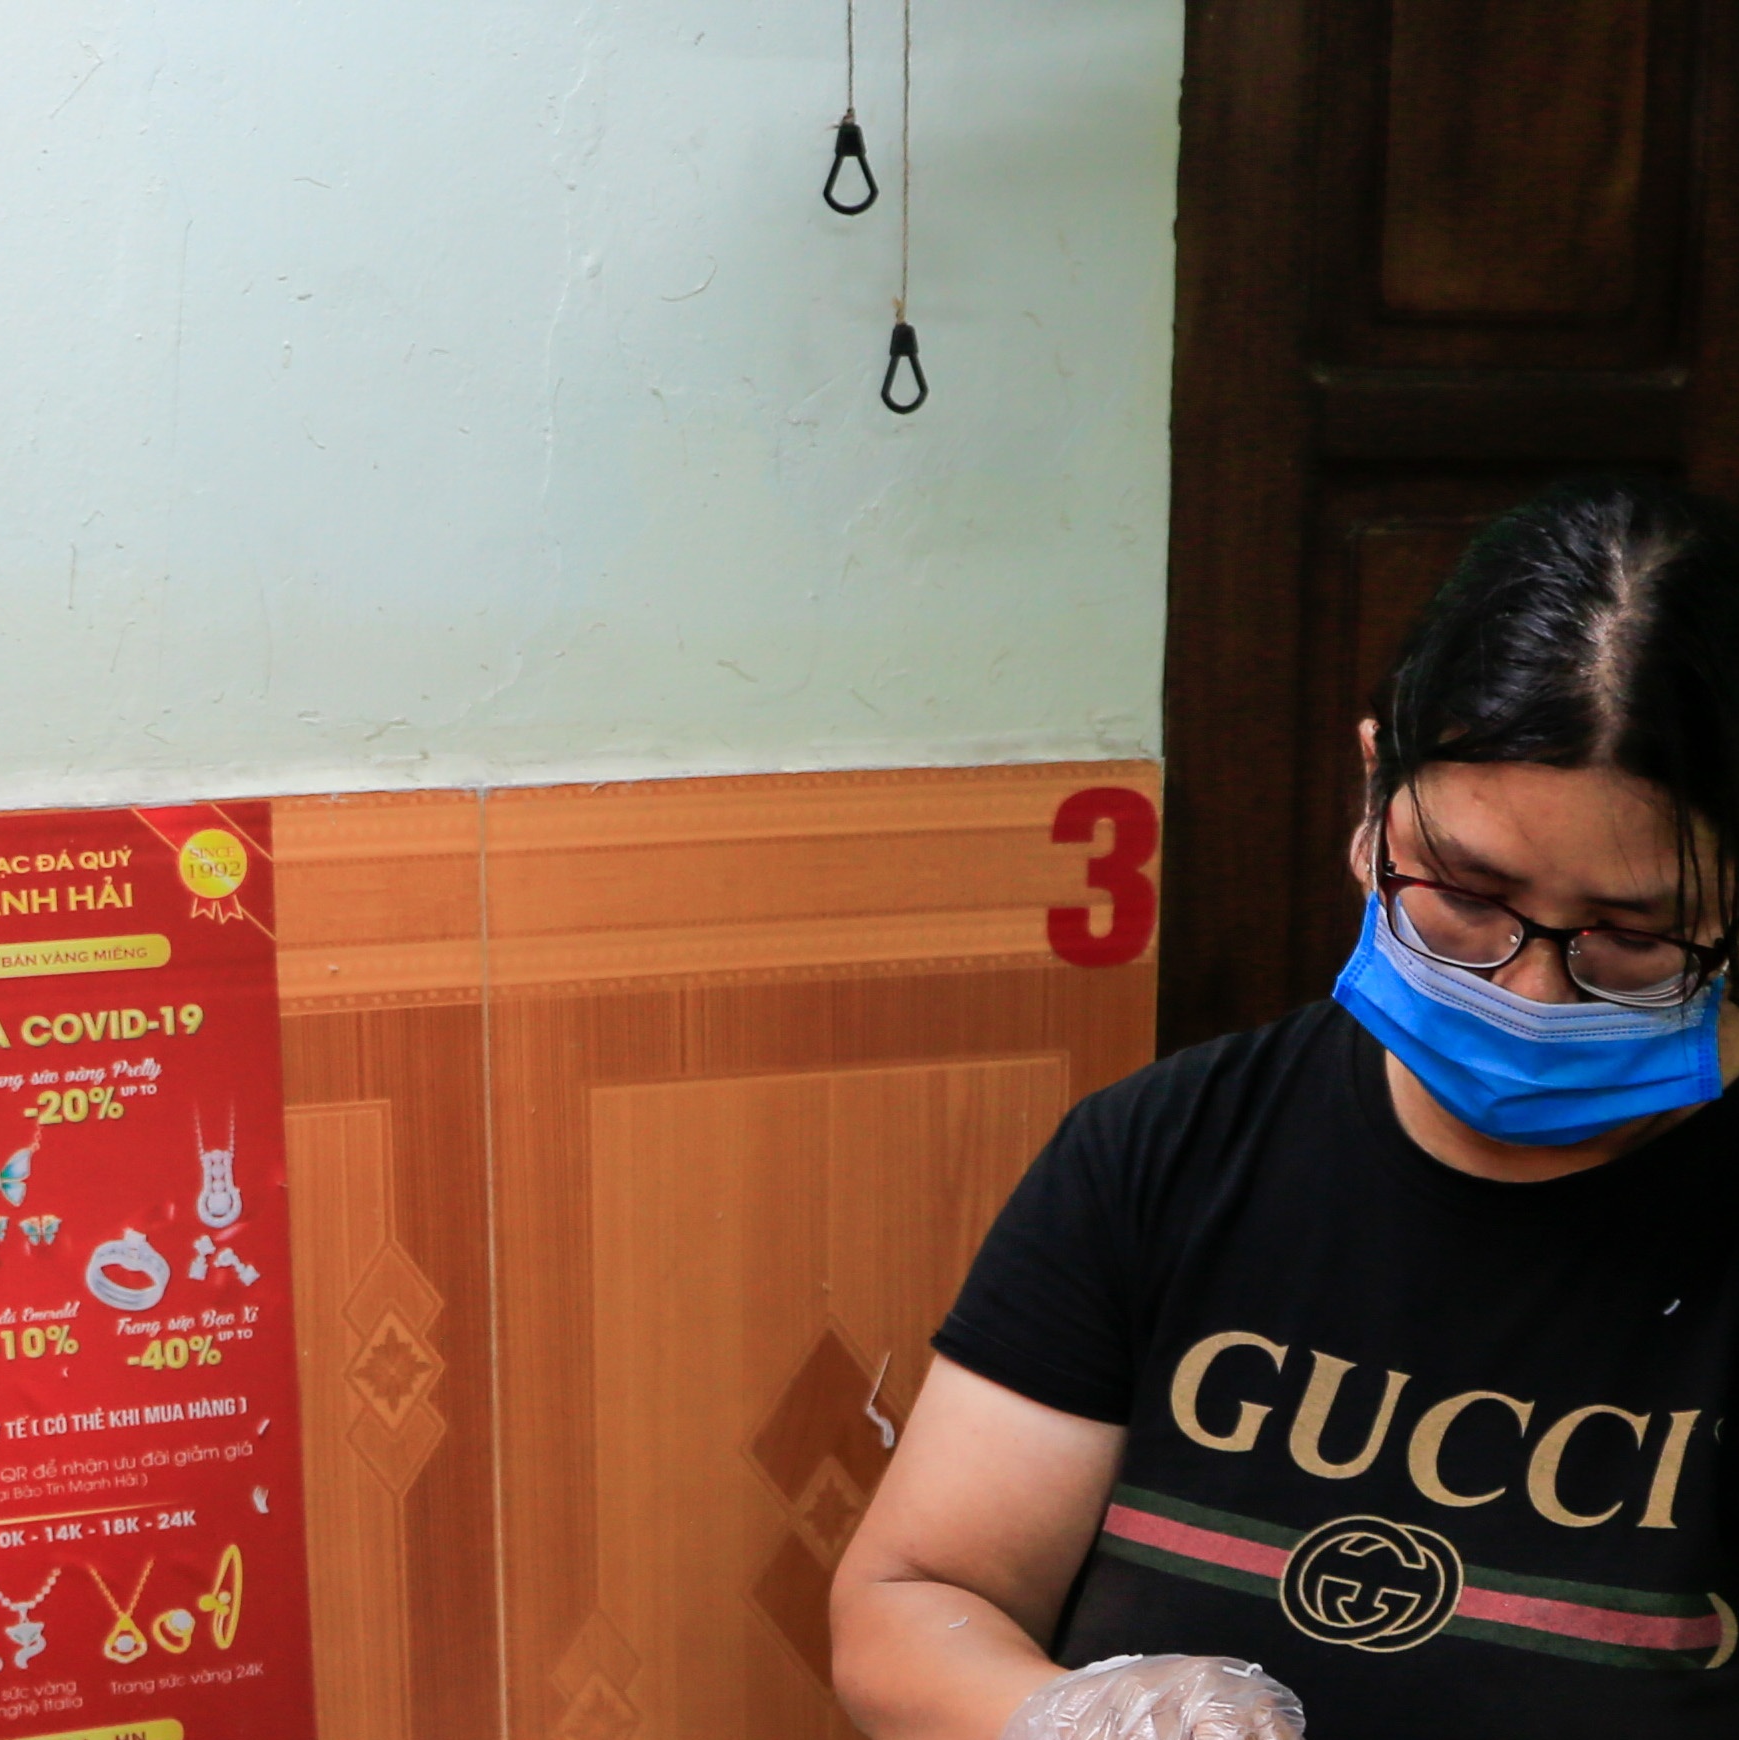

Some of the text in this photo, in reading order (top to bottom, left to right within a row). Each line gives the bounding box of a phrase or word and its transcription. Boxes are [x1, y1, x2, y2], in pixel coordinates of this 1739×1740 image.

[36, 851, 74, 872] ĐÁ
[79, 846, 132, 870] QUÝ
[189, 861, 241, 880] 1992
[190, 846, 235, 859] SINCE
[68, 876, 133, 911] HẢI
[1047, 787, 1158, 968] 3
[2, 953, 38, 968] BÁN
[43, 950, 88, 964] VÀNG
[94, 946, 148, 961] MIẾNG
[21, 1004, 204, 1047] COVID-19
[24, 1084, 157, 1125] -20% UP TO
[126, 1328, 253, 1370] -40% UP TO
[5, 1416, 30, 1438] TẾ
[43, 1413, 68, 1436] CÓ
[72, 1407, 105, 1431] THẺ
[110, 1407, 140, 1428] KHI
[145, 1402, 185, 1424] MUA
[188, 1397, 236, 1418] HÀNG
[1170, 1331, 1703, 1531] GUCCI
[0, 1466, 28, 1484] QR
[62, 1457, 109, 1477] nhận
[225, 1441, 253, 1461] giá
[45, 1523, 83, 1543] 14K
[102, 1516, 140, 1535] 18K
[158, 1510, 196, 1530] 24K
[110, 1681, 155, 1696] Trang
[236, 1663, 264, 1679] 24K
